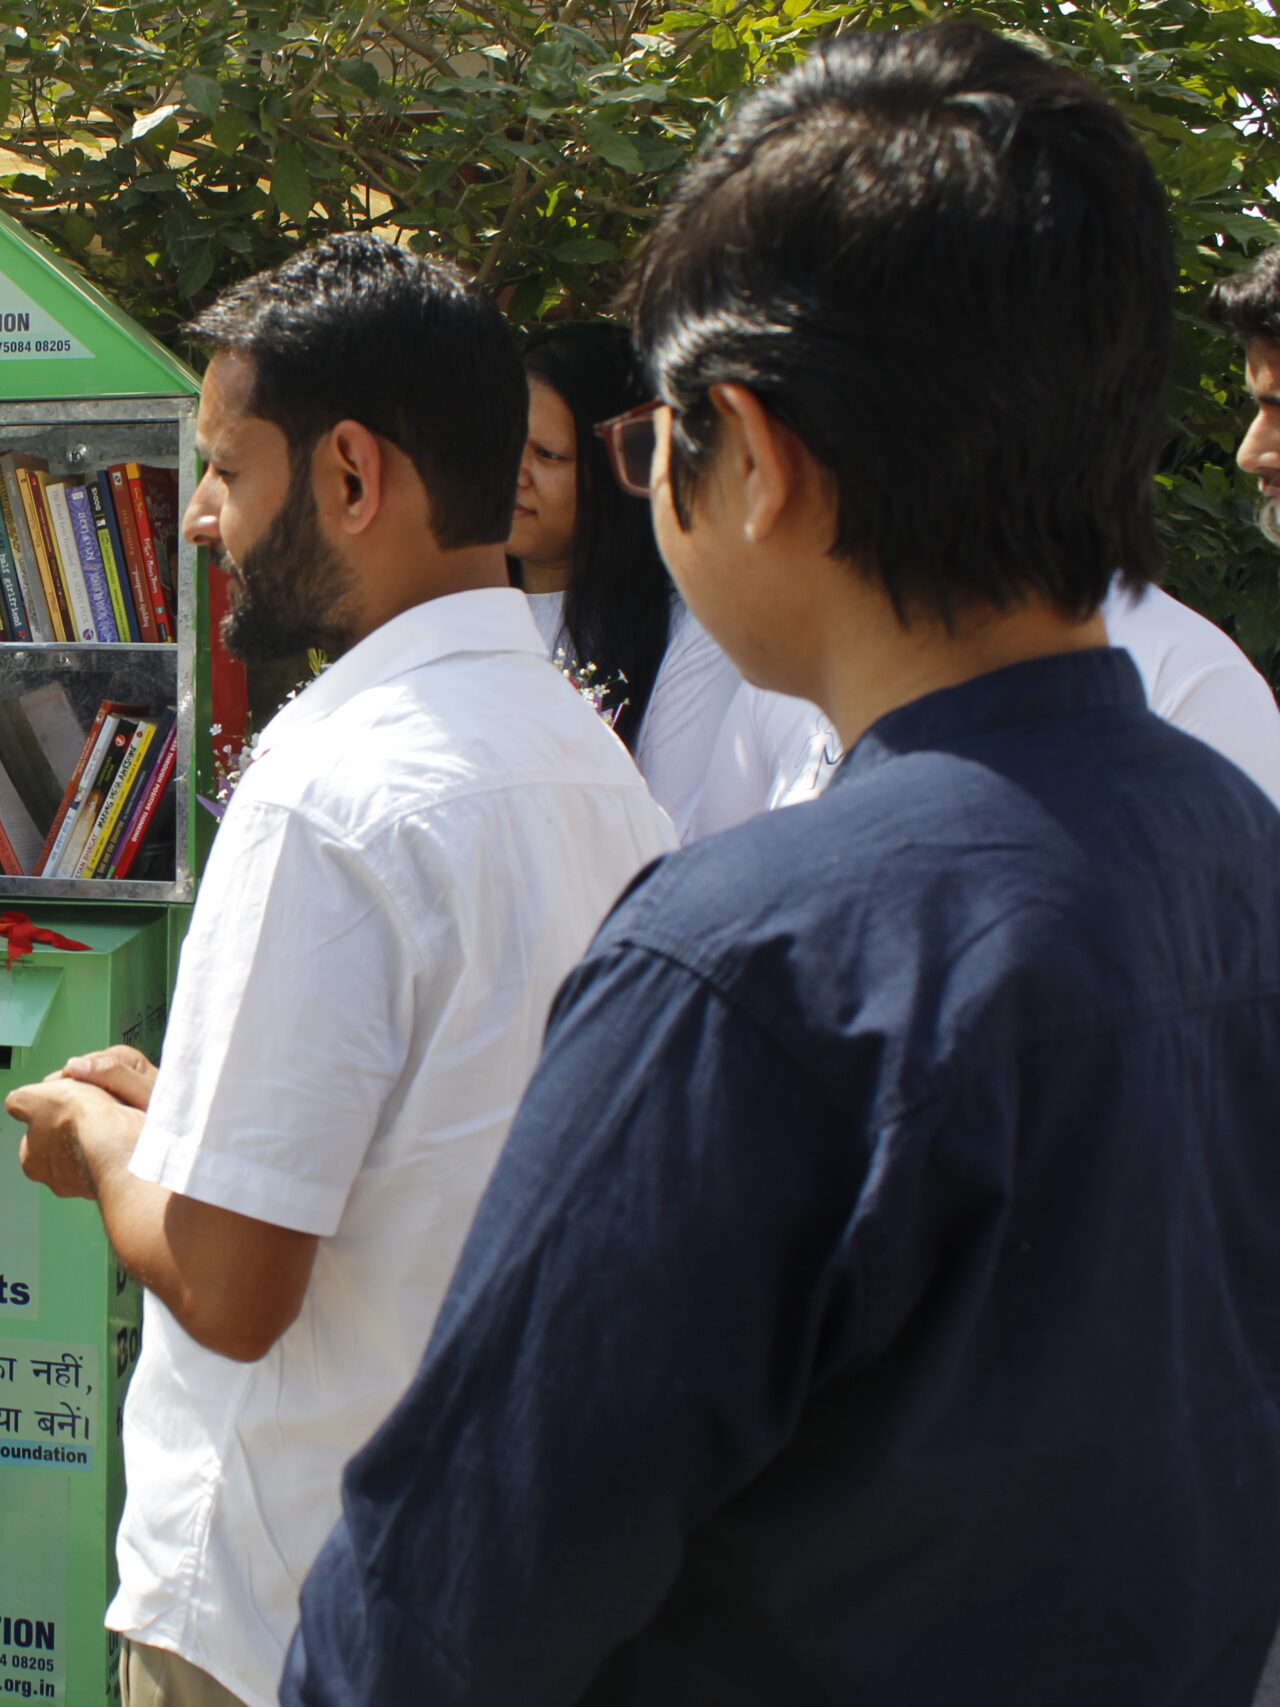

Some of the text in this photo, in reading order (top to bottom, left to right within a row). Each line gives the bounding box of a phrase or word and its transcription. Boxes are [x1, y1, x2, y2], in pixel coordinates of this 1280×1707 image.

[36, 340, 70, 351] 08205
[2, 576, 22, 627] girlfriend
[139, 603, 150, 627] happily
[96, 799, 113, 829] MAKING
[108, 780, 121, 800] INDIA
[117, 744, 137, 780] AWESOME
[130, 751, 173, 843] THROUGH POSITIVE THINKING
[82, 833, 98, 861] BHAGAT
[12, 1656, 53, 1671] 08205
